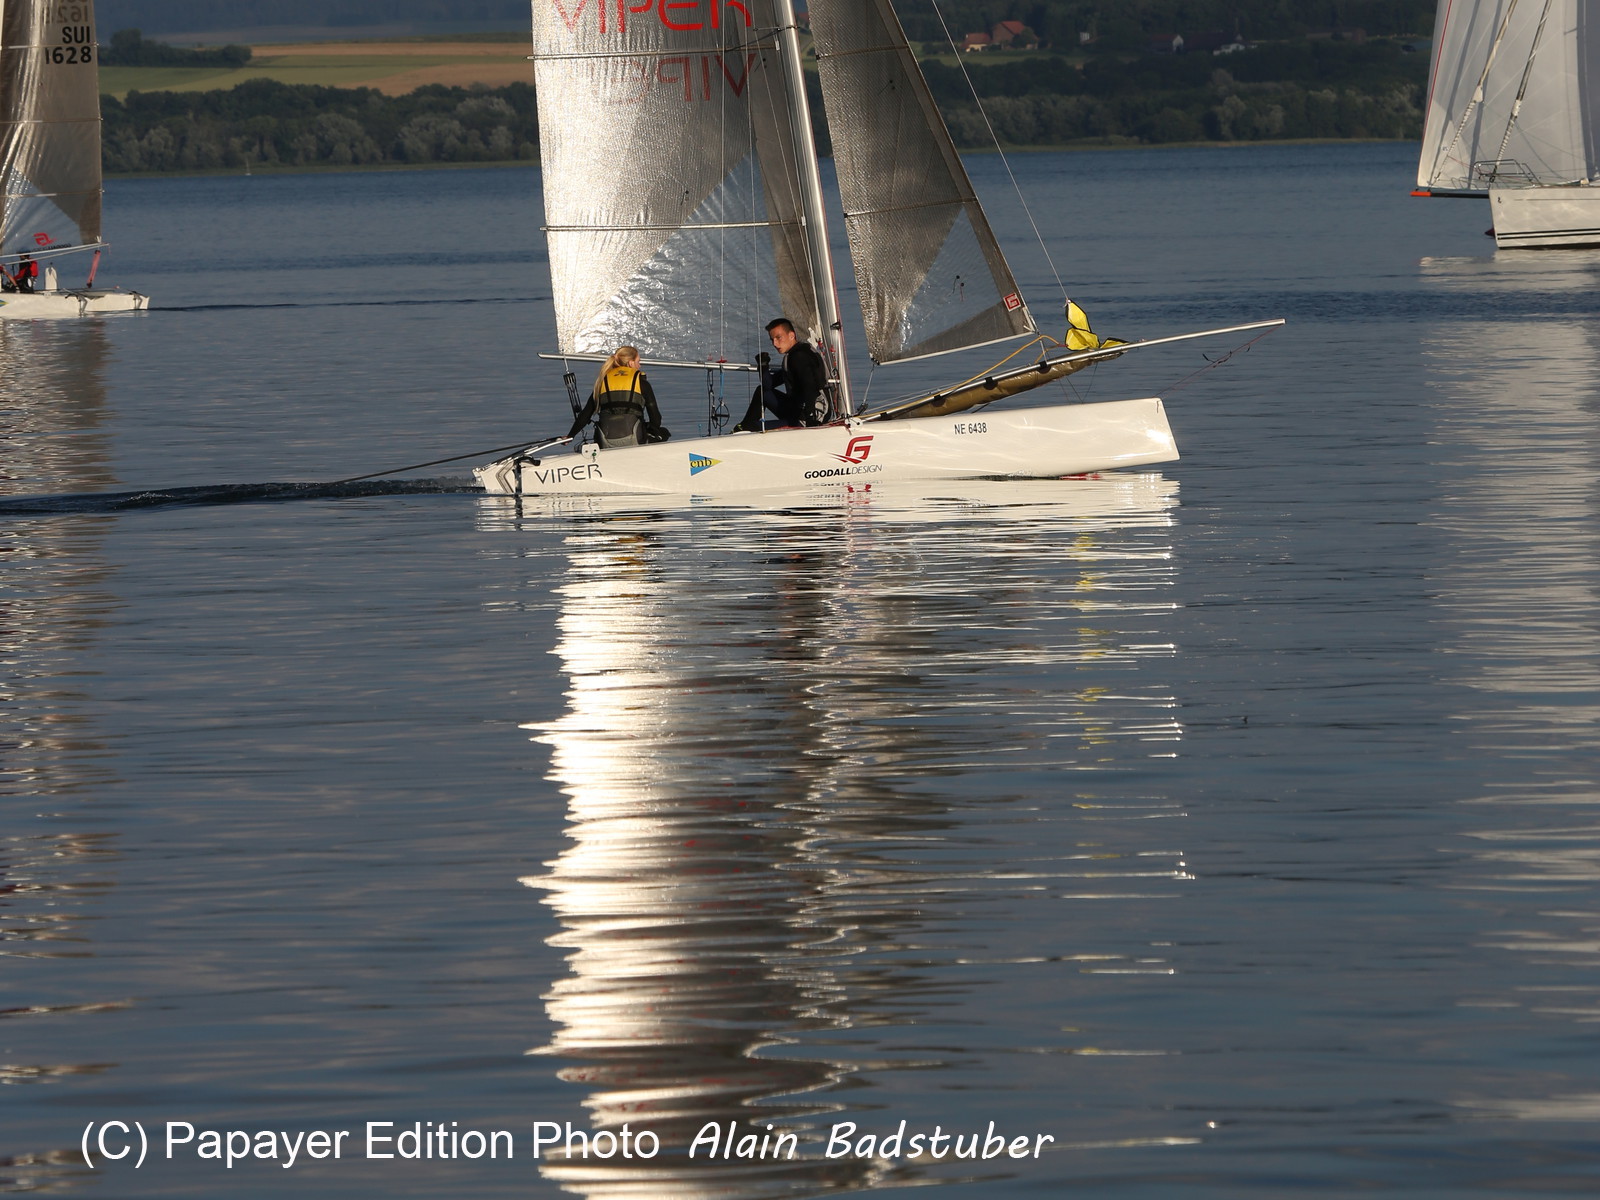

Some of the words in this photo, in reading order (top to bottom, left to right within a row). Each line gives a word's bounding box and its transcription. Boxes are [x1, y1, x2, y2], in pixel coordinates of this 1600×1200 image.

[62, 26, 91, 44] SUI
[45, 46, 92, 64] 1628
[954, 423, 966, 435] NE
[968, 422, 987, 434] 6438
[690, 456, 712, 468] cnb
[534, 463, 603, 484] VIPER
